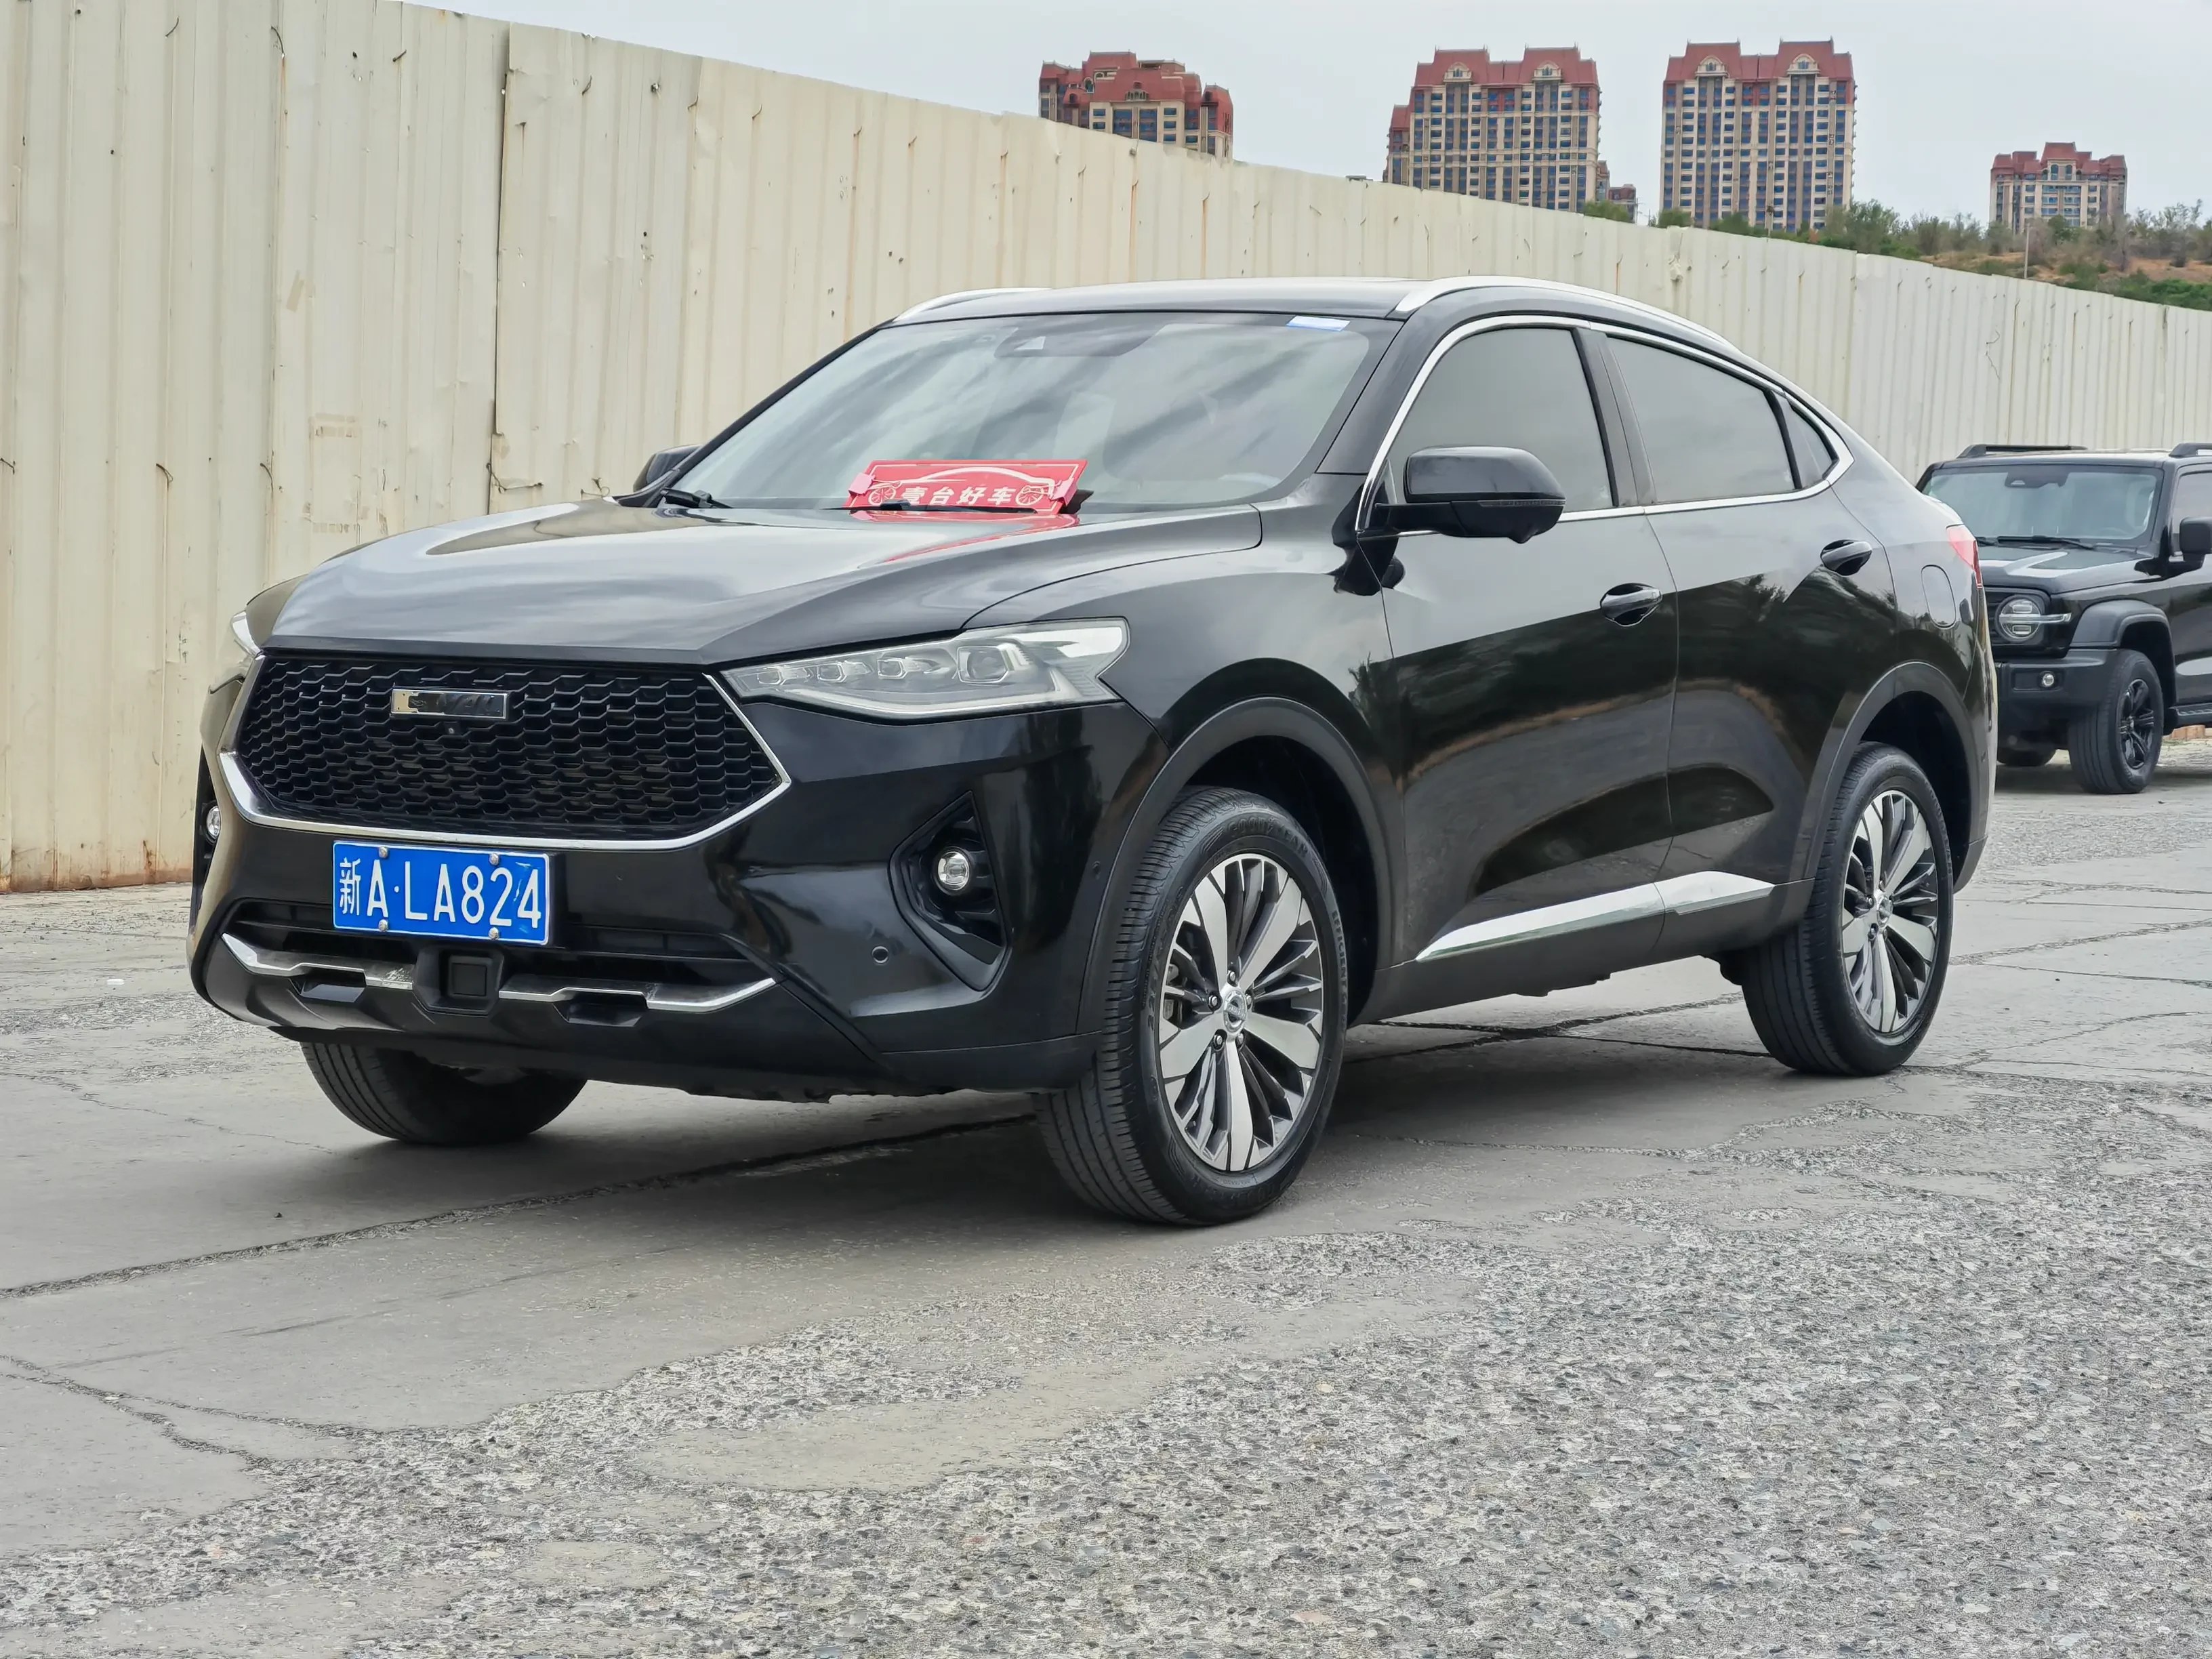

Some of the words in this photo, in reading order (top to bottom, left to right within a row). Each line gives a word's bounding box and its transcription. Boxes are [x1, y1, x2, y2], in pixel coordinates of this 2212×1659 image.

[901, 486, 1017, 506] 壹台好车
[339, 857, 541, 928] 新A·LA824
